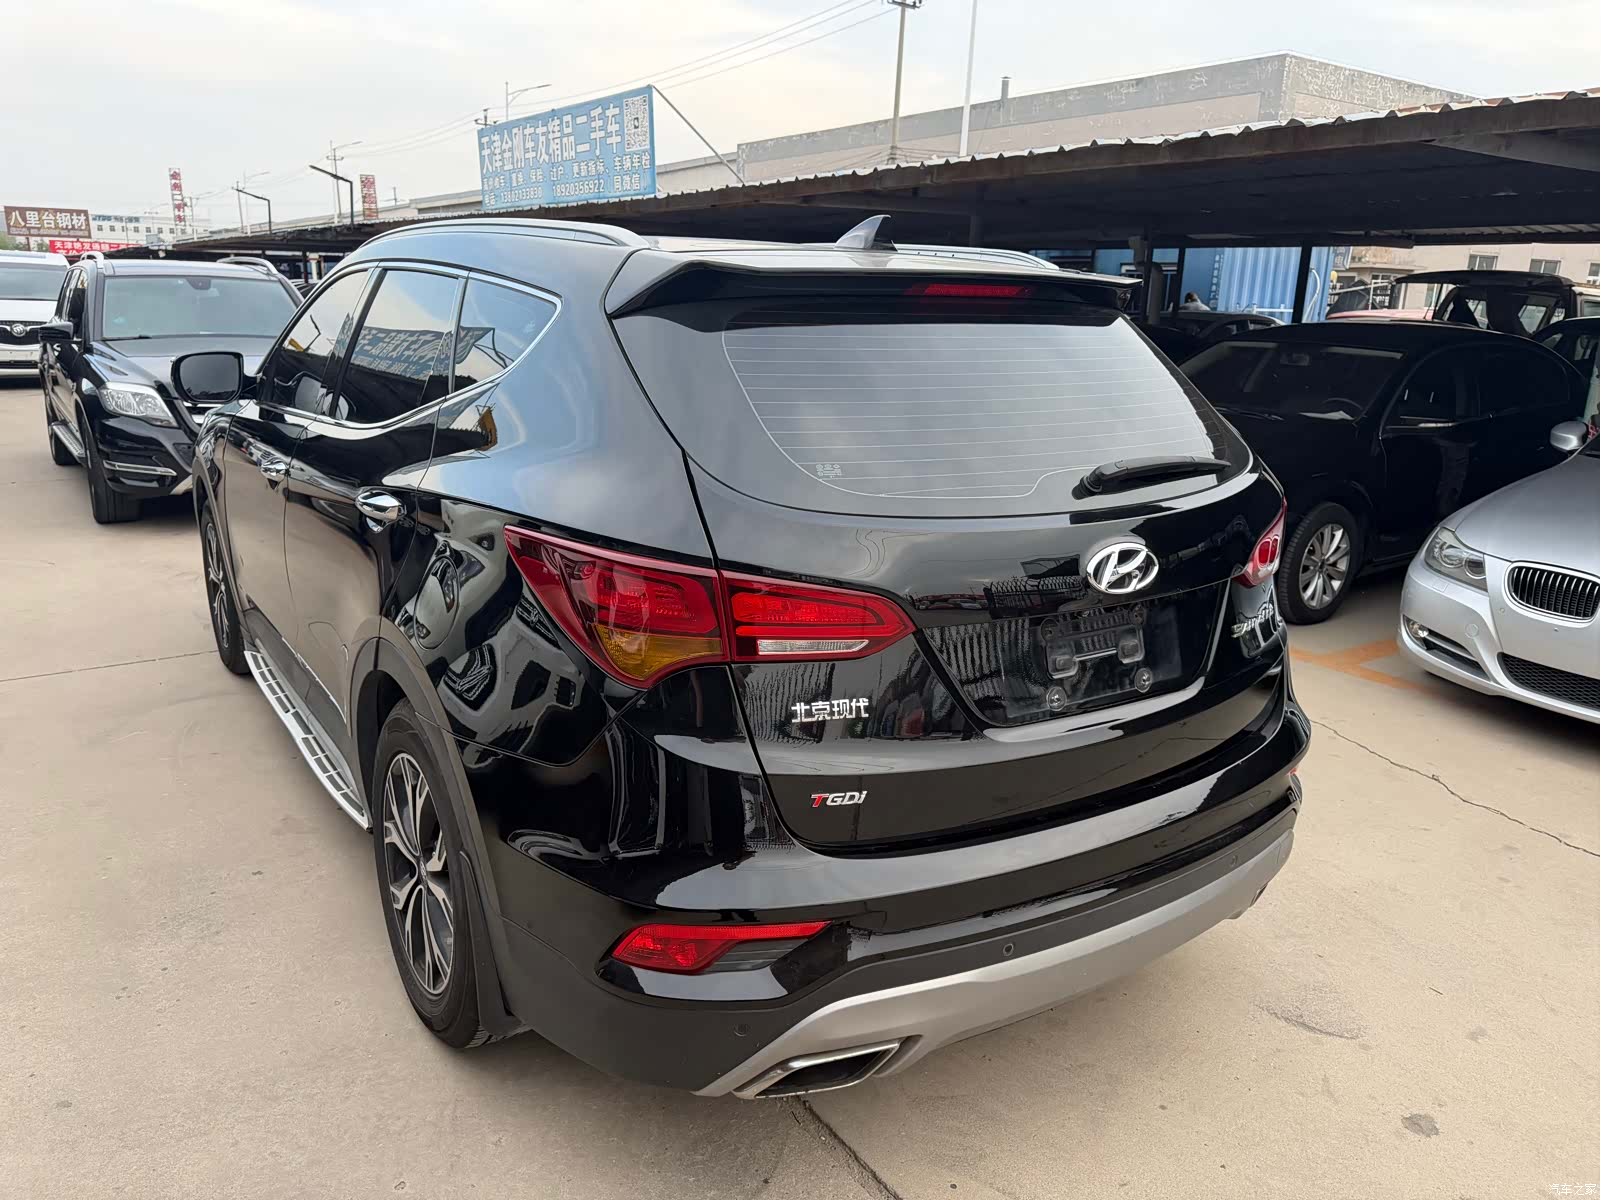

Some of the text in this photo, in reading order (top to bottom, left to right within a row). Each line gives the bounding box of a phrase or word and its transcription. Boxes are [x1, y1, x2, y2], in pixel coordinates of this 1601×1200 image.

[481, 103, 621, 174] 天津金刚车友精品二手车
[10, 210, 87, 230] 八里台钢材
[791, 697, 869, 723] 北京现代
[811, 790, 868, 808] TGDi
